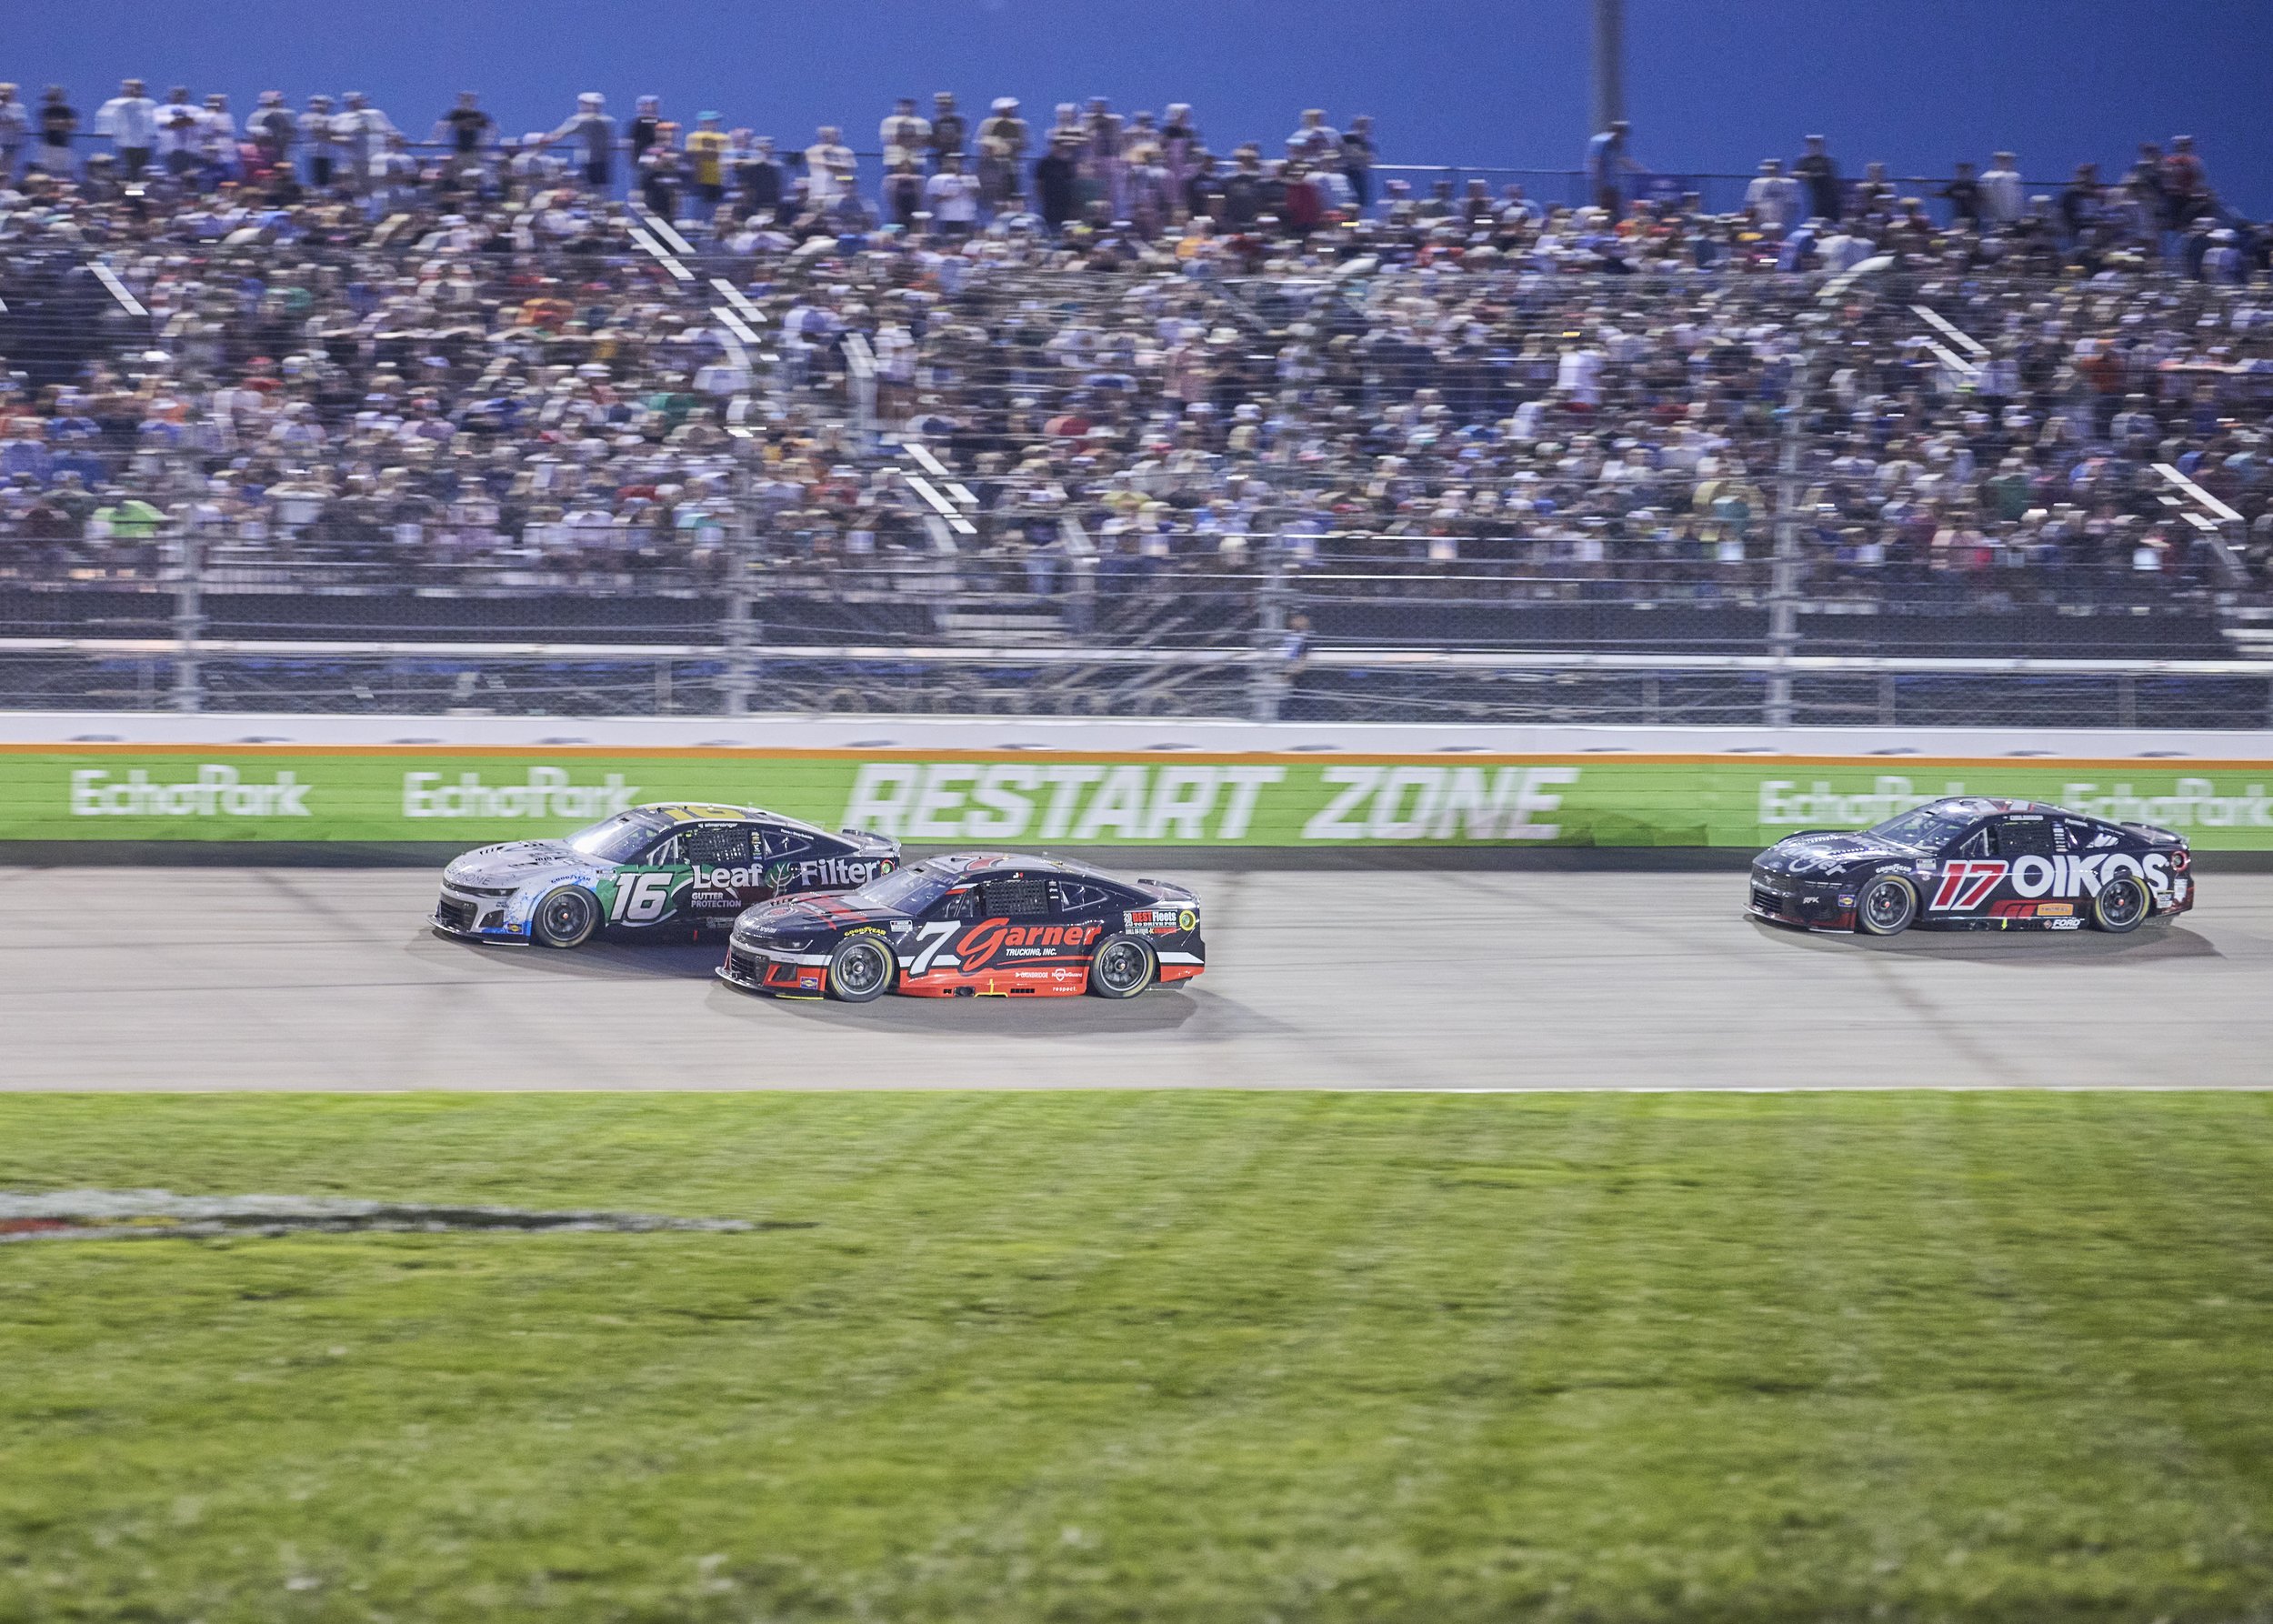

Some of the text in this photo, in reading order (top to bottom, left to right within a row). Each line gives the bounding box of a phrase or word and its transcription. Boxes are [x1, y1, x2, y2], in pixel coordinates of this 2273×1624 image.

[71, 764, 314, 816] EchoPark
[404, 767, 641, 818] EchoPark
[841, 763, 1582, 839] RESTART ZONE
[1758, 776, 1965, 824] EchoP
[551, 874, 592, 884] GOODYEAR
[692, 858, 877, 889] Leaf Filter
[1876, 863, 1912, 874] GOODYEAR
[1929, 860, 2009, 910] 17
[2011, 853, 2169, 897] OIKOS
[610, 873, 674, 921] 16
[691, 892, 724, 900] GUTTER
[691, 899, 741, 907] PROTECTION
[844, 926, 887, 937] GOODYEAR
[1132, 911, 1177, 922] BEST Fleets
[2052, 918, 2081, 927] FORD
[909, 920, 962, 976] 7
[956, 917, 1103, 972] Garner
[1006, 947, 1057, 957] TRUCKING, INC.
